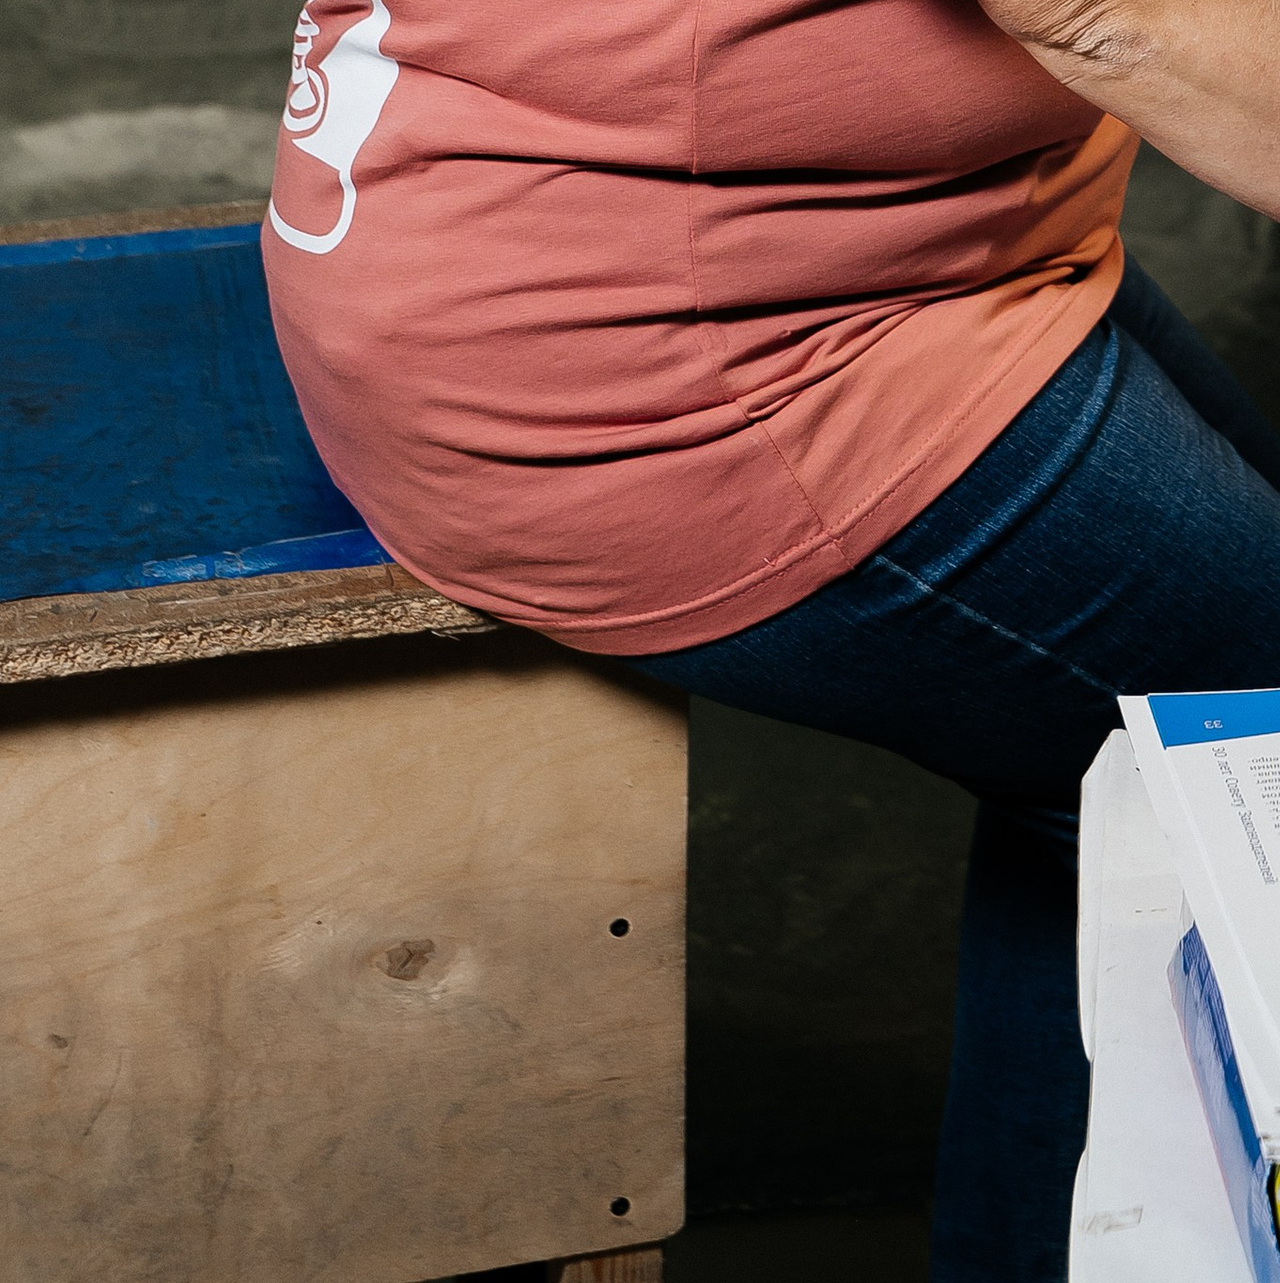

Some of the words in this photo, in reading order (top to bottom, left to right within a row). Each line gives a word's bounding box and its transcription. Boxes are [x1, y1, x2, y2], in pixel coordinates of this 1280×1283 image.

[1204, 719, 1223, 729] 33
[1212, 746, 1227, 759] 30
[1218, 760, 1232, 775] лет
